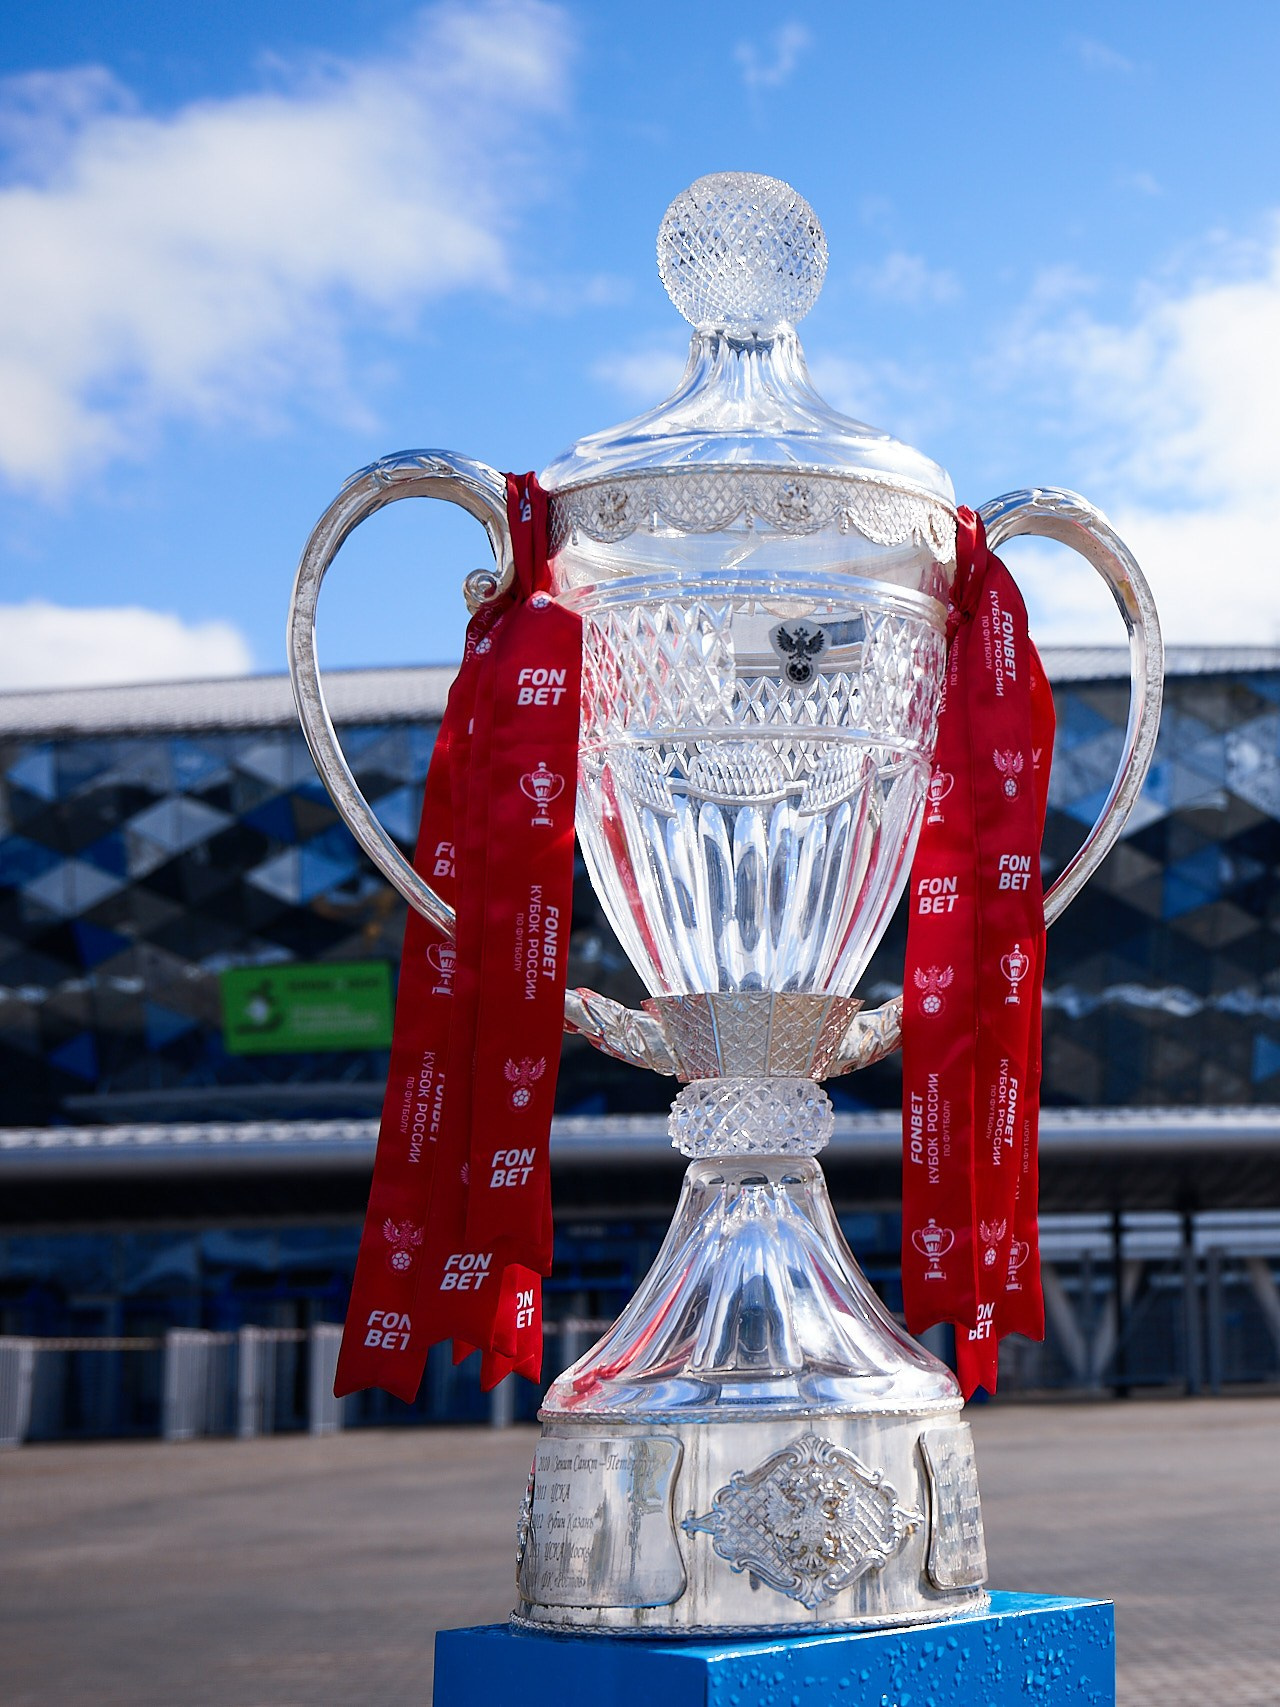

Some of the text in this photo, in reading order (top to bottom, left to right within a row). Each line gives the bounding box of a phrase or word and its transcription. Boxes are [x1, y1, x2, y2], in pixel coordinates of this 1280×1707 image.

[981, 615, 992, 670] ПО ФУТБОЛУ
[989, 590, 1005, 697] КУБОК РОССИИ
[1001, 610, 1016, 681] FONBET
[517, 668, 567, 686] FON
[517, 687, 567, 705] BET
[998, 854, 1031, 872] FON
[918, 876, 958, 895] FON
[998, 872, 1031, 891] BET
[918, 894, 959, 914] BET
[514, 912, 524, 972] ПО ФУТБОЛУ
[525, 885, 542, 1000] КУБОК РОССИИ
[542, 905, 559, 981] FONBET
[990, 1084, 997, 1098] ПО
[400, 1076, 415, 1134] ПО ФУТБОЛУ
[408, 1051, 436, 1163] КУБОК РОССИИ
[993, 1058, 1009, 1166] КУБОК РОССИИ
[1004, 1077, 1018, 1148] FONBET
[911, 1091, 923, 1165] FONBET
[927, 1073, 940, 1184] КУБОК РОССИИ
[942, 1100, 951, 1157] ПО ФУТБОЛУ
[491, 1147, 537, 1168] FON
[490, 1166, 534, 1188] BET
[444, 1252, 493, 1271] FON
[440, 1272, 490, 1291] BET
[516, 1289, 534, 1310] ON
[516, 1307, 535, 1329] ET
[976, 1302, 995, 1321] ON
